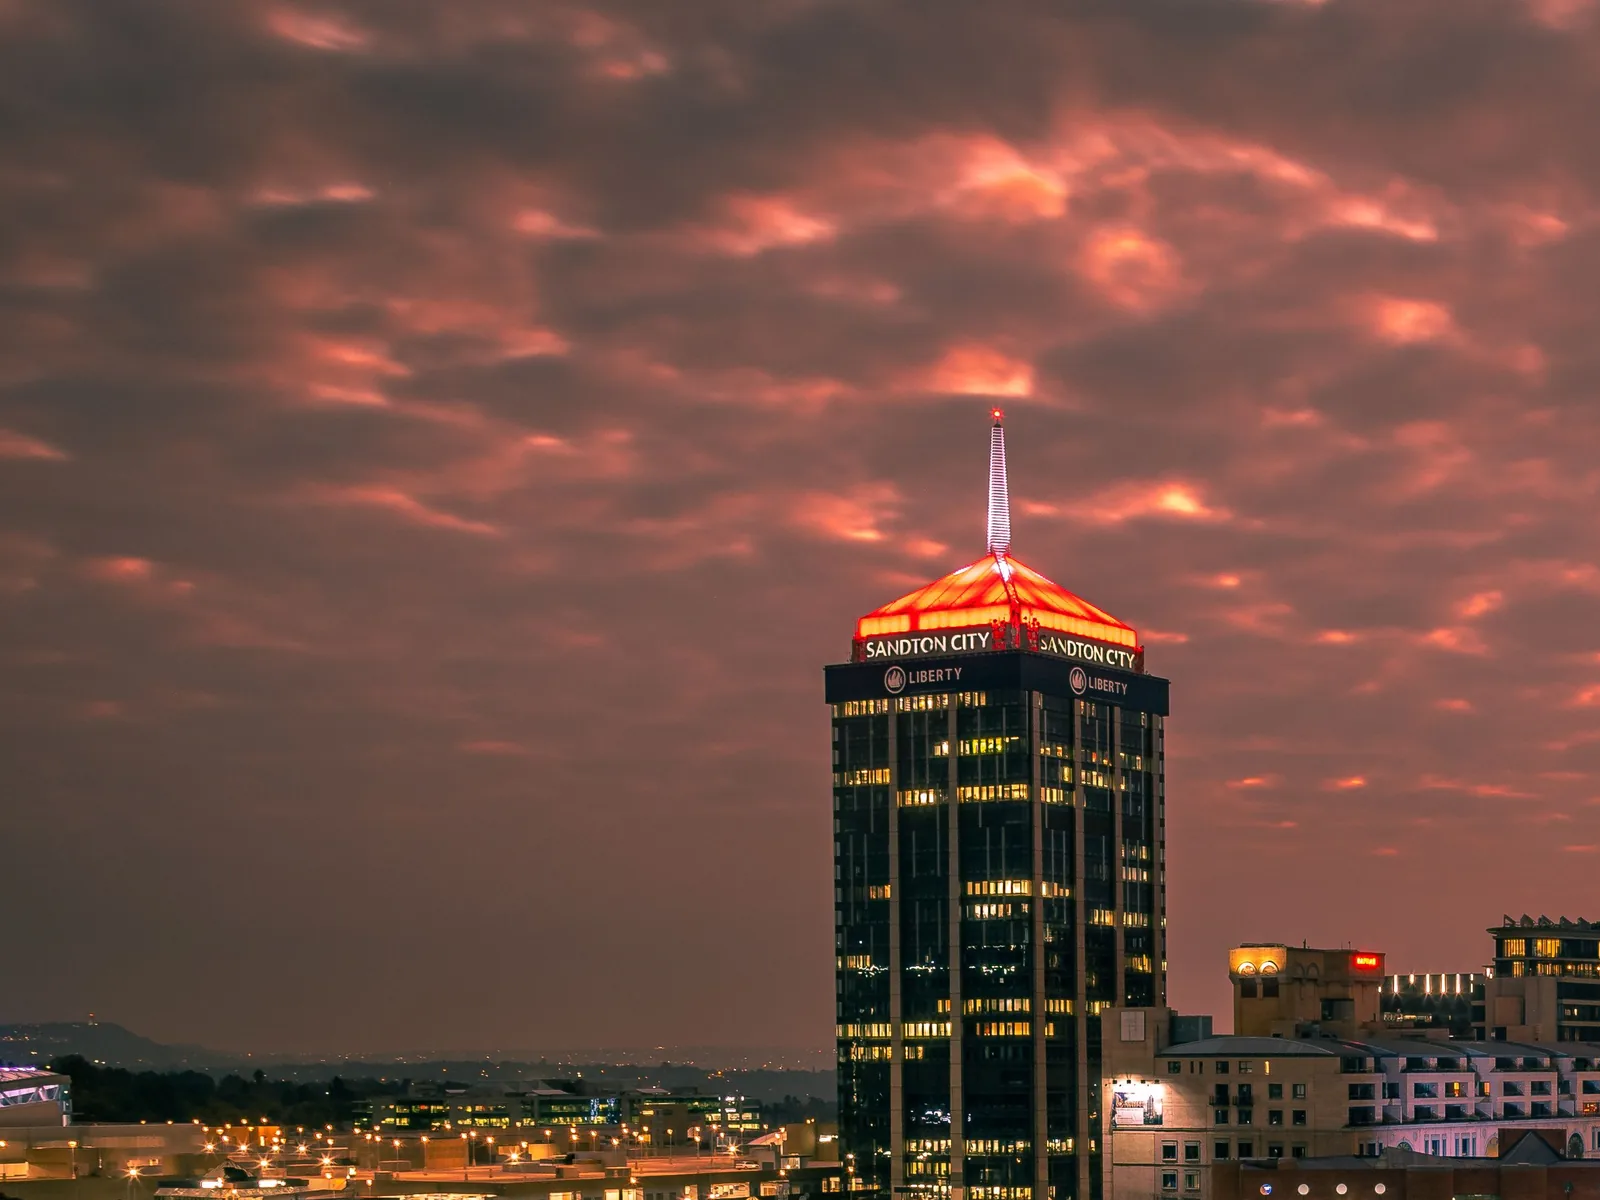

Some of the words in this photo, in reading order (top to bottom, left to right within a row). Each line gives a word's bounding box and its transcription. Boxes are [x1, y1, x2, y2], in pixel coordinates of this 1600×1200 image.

[866, 636, 947, 658] SANDTON
[950, 632, 990, 651] CITY
[1040, 637, 1104, 662] SANDTON
[1105, 649, 1136, 669] CITY
[909, 667, 962, 684] LIBERTY
[1088, 676, 1128, 695] LIBERTY
